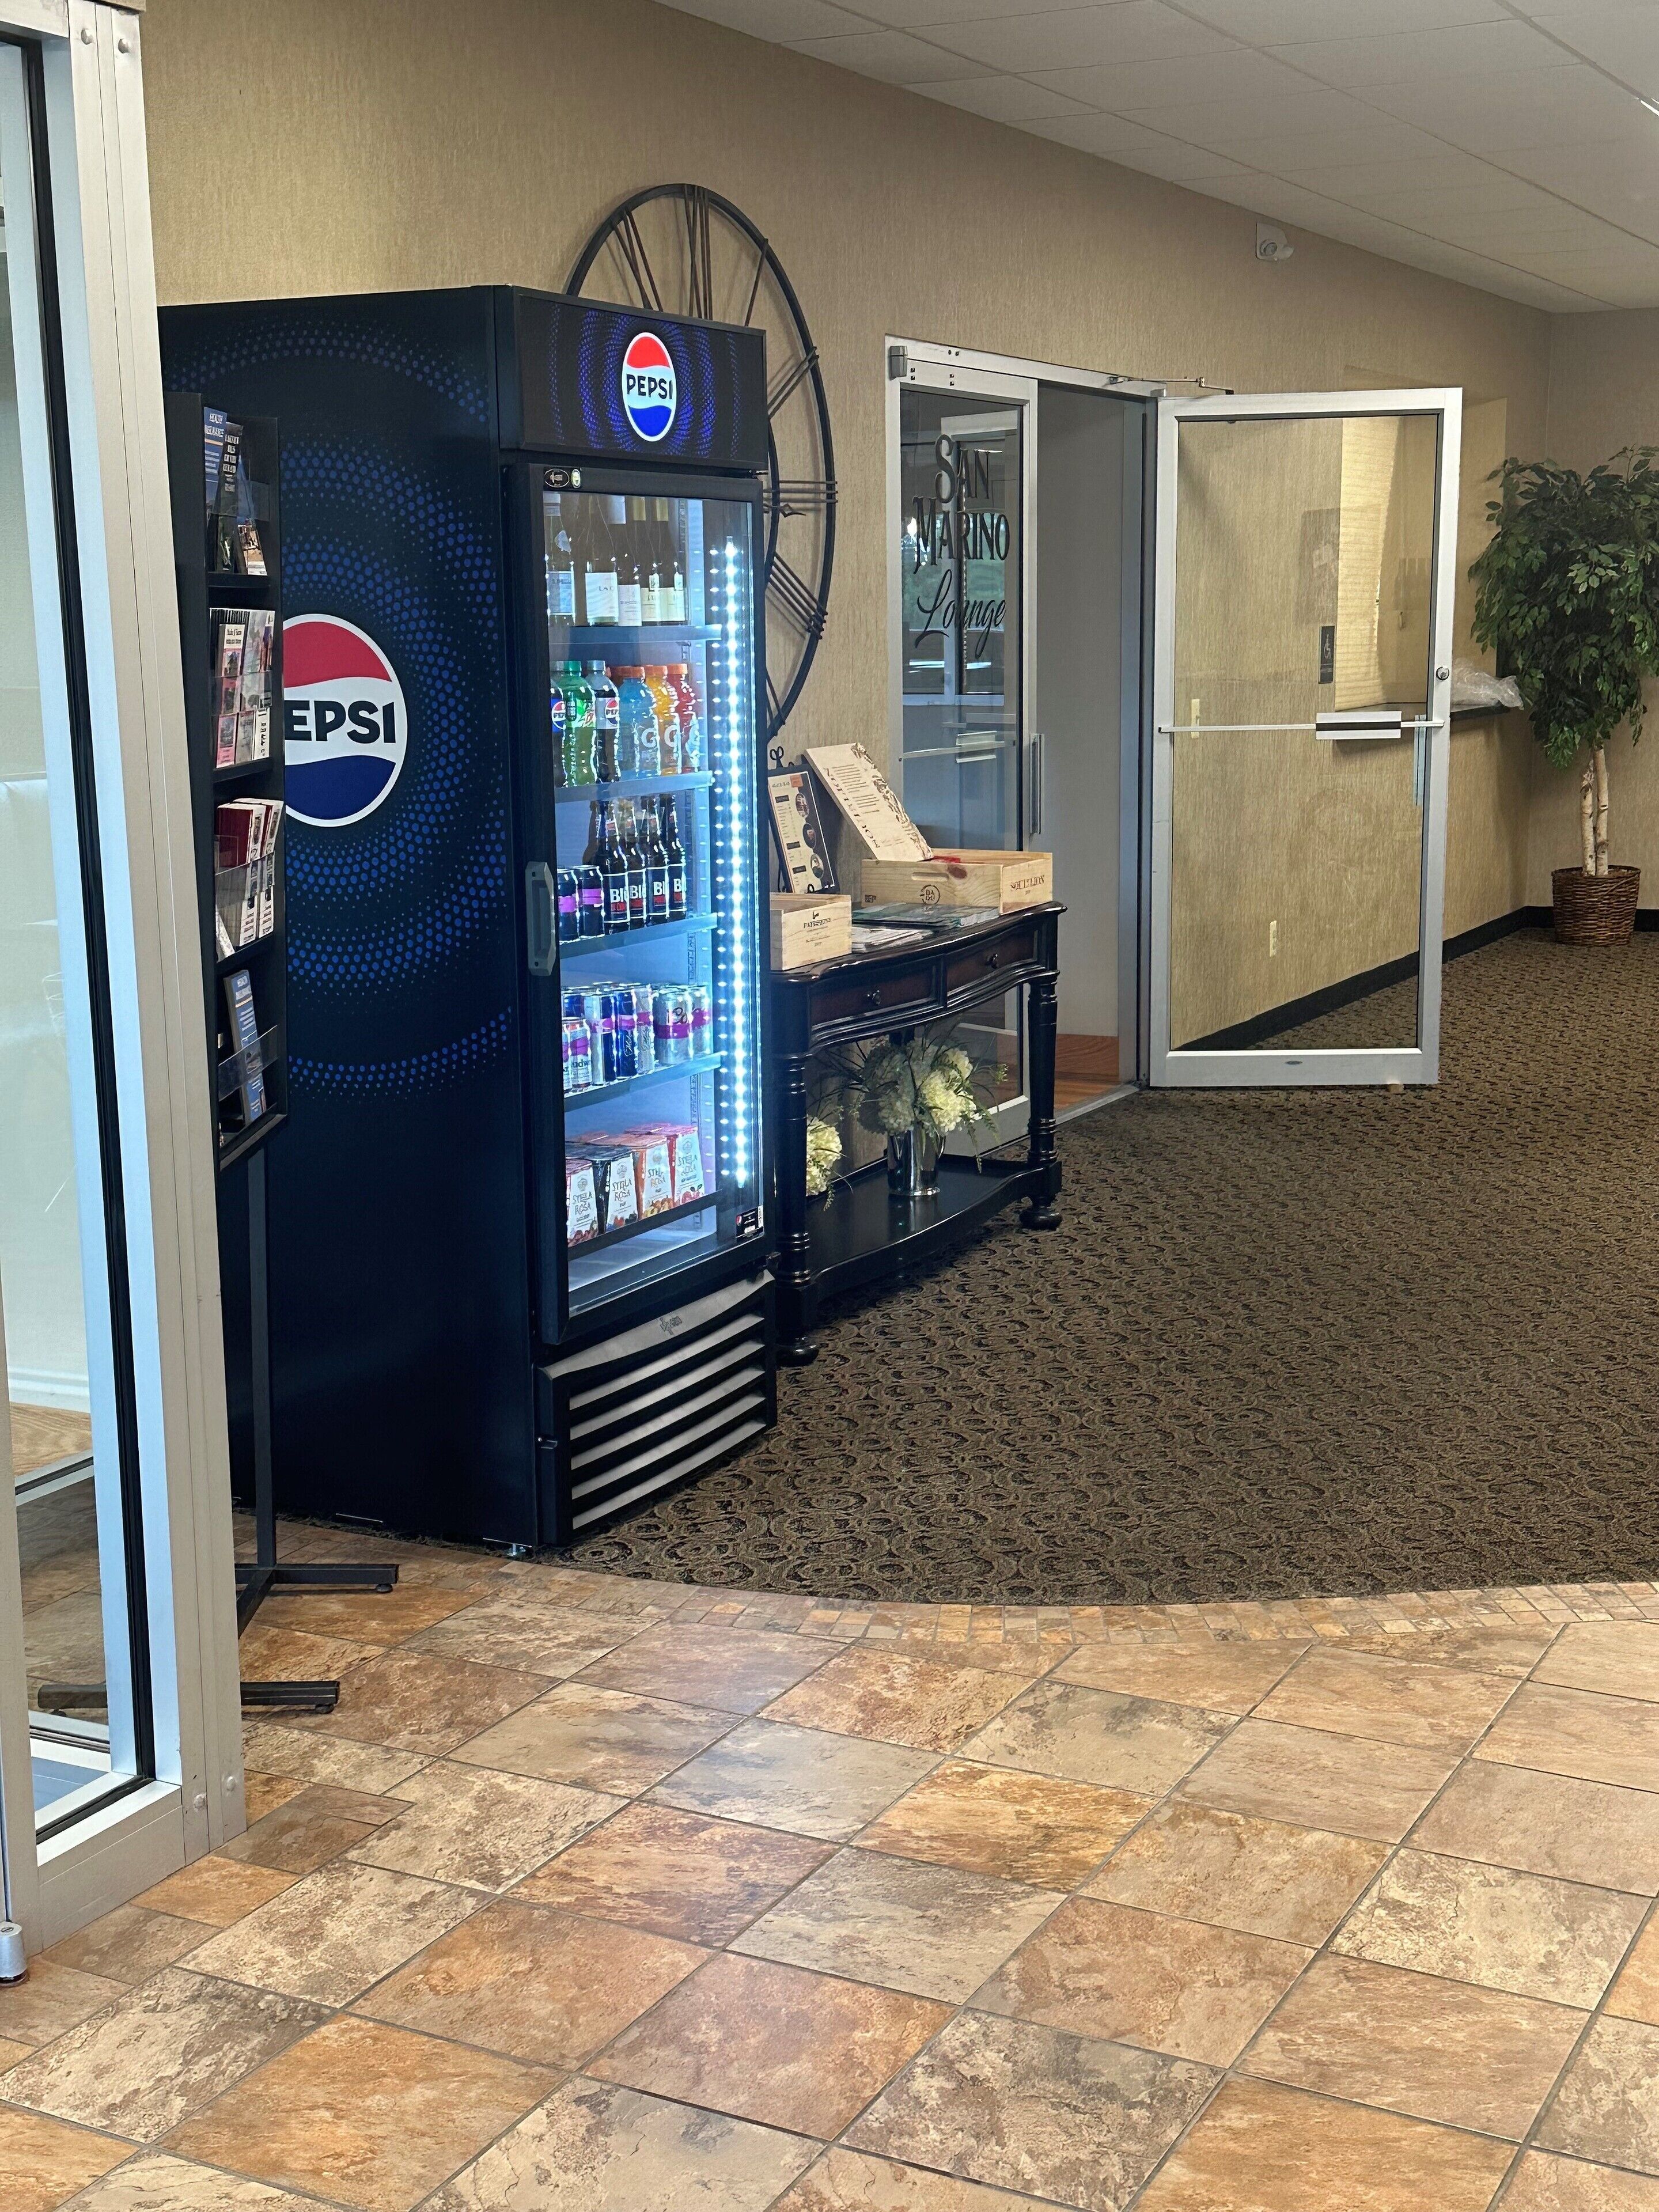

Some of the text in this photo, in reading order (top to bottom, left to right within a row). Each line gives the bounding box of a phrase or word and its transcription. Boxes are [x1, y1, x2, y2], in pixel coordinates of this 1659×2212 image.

[626, 373, 673, 399] PEPSI
[934, 434, 990, 503] SAN
[912, 496, 1010, 574] MARINO
[914, 569, 1006, 658] Lounge
[284, 700, 396, 744] EPSI
